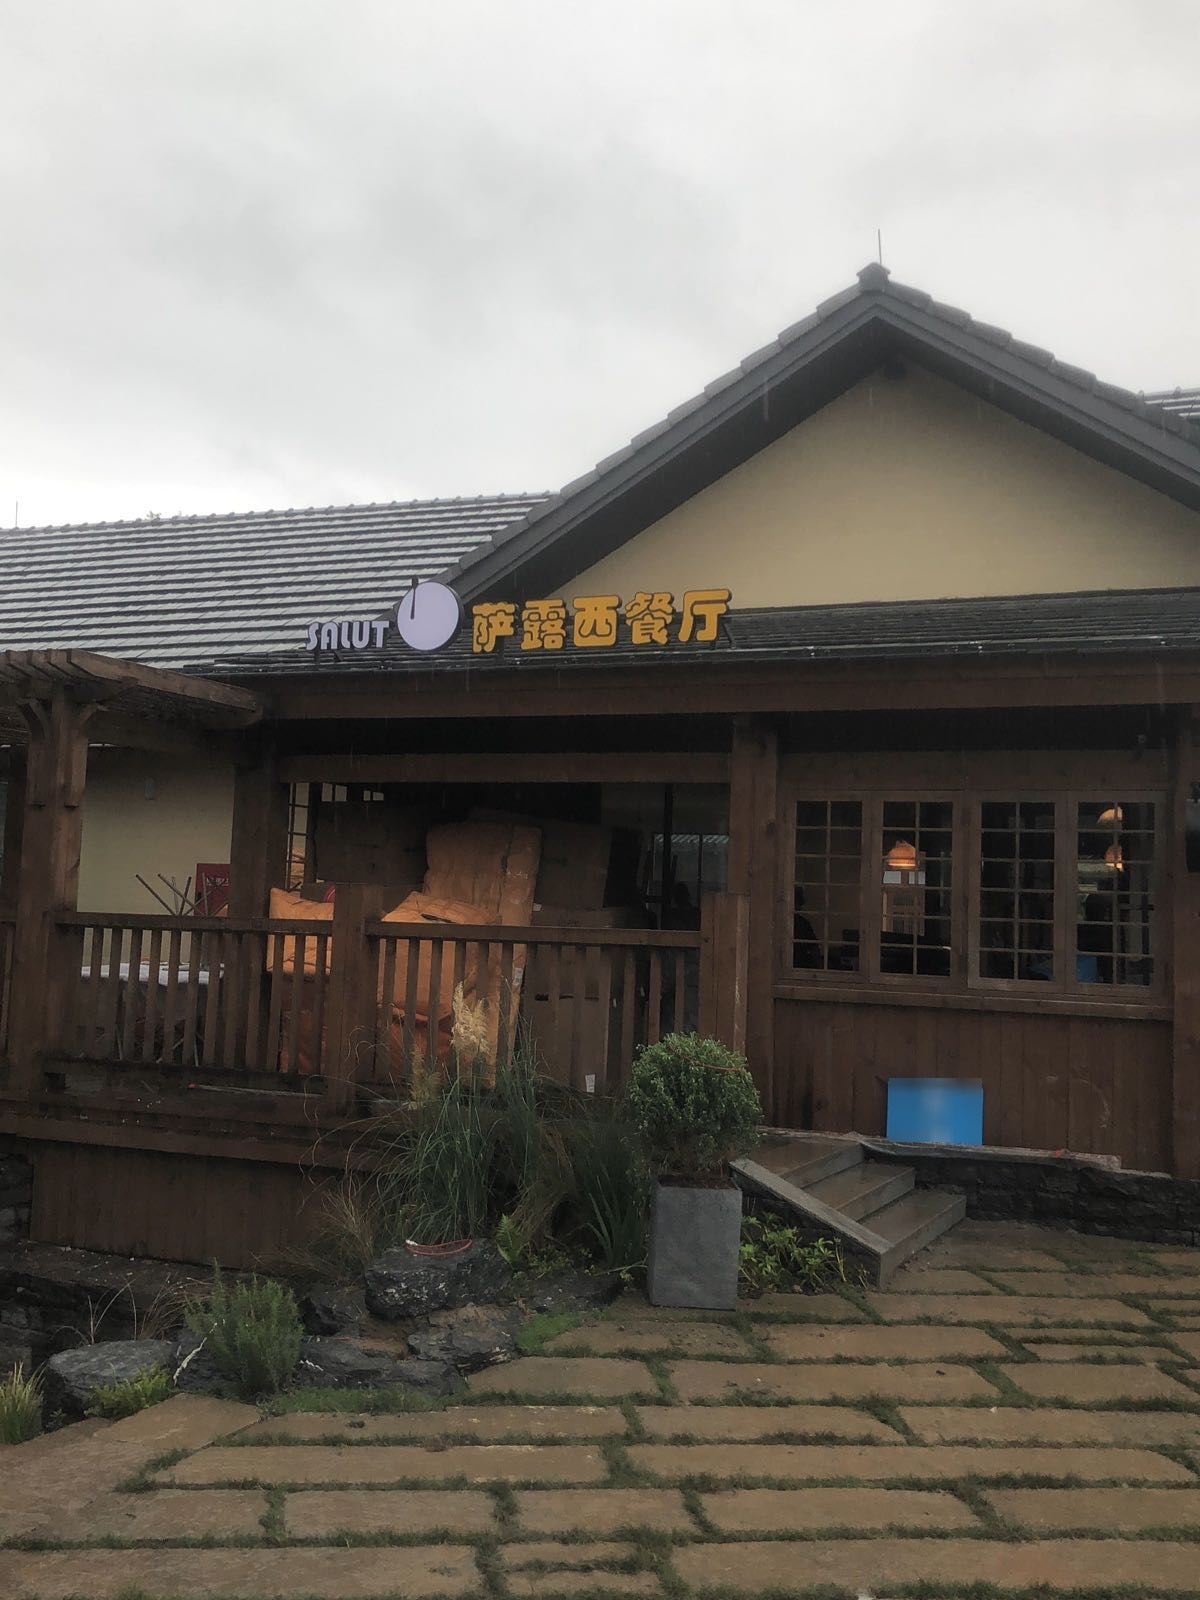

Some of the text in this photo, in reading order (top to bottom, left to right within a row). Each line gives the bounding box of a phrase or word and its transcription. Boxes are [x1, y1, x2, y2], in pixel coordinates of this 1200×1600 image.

[306, 619, 390, 651] SALUT
[472, 589, 732, 653] 萨露西餐厅
